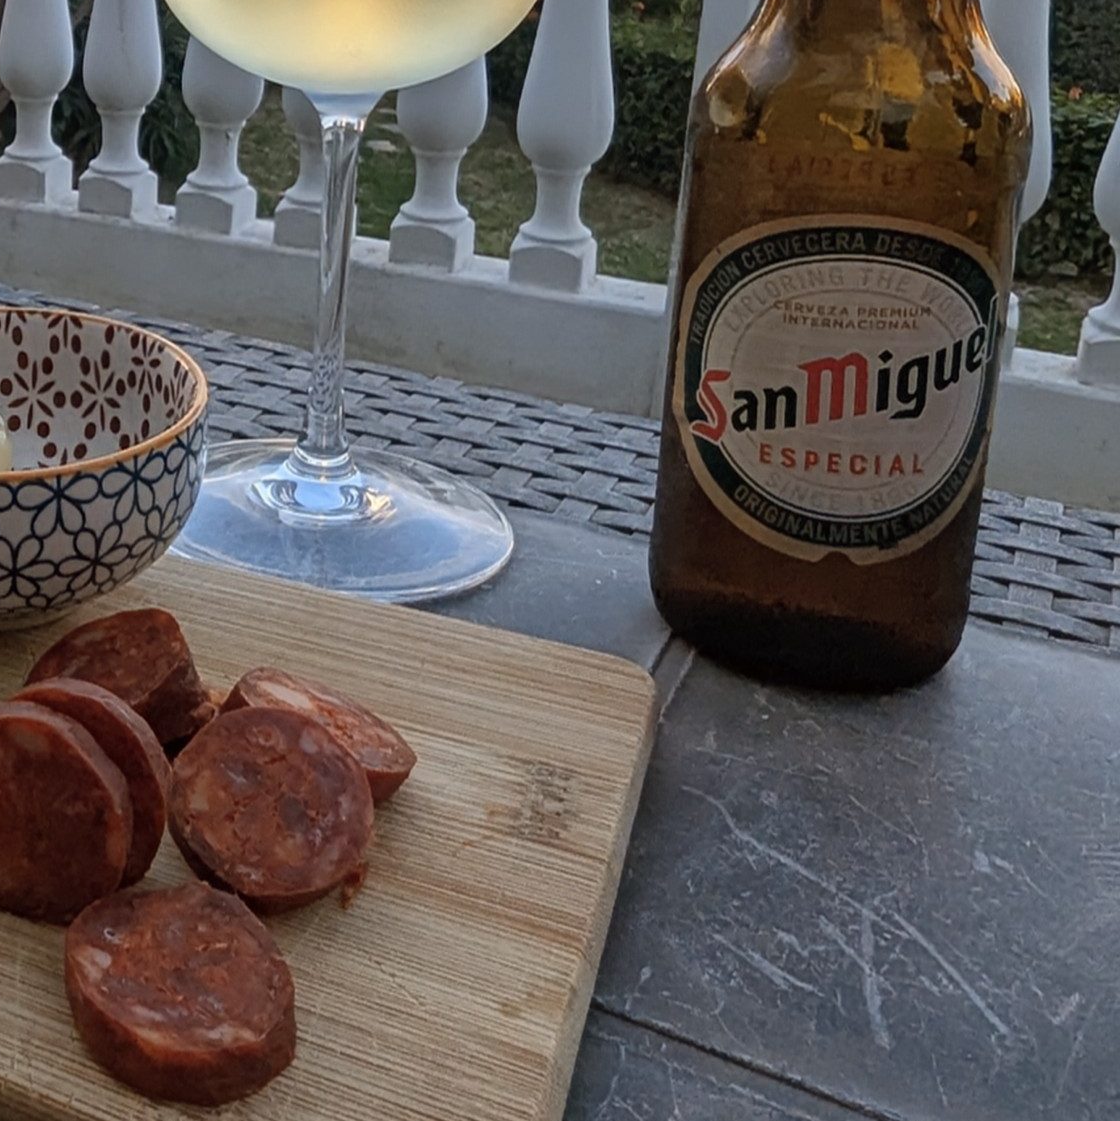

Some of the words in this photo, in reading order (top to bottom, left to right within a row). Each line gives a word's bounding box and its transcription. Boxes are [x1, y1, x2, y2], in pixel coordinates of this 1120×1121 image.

[741, 233, 865, 269] CERVECERA
[861, 267, 911, 293] THE
[772, 300, 849, 317] CERVEZA
[857, 306, 931, 318] PREMIUM
[783, 312, 919, 330] INTERNACIONAL
[758, 443, 925, 478] ESPECIAL
[734, 485, 904, 544] ORIGINALMENTE
[909, 457, 973, 527] NATURAL
